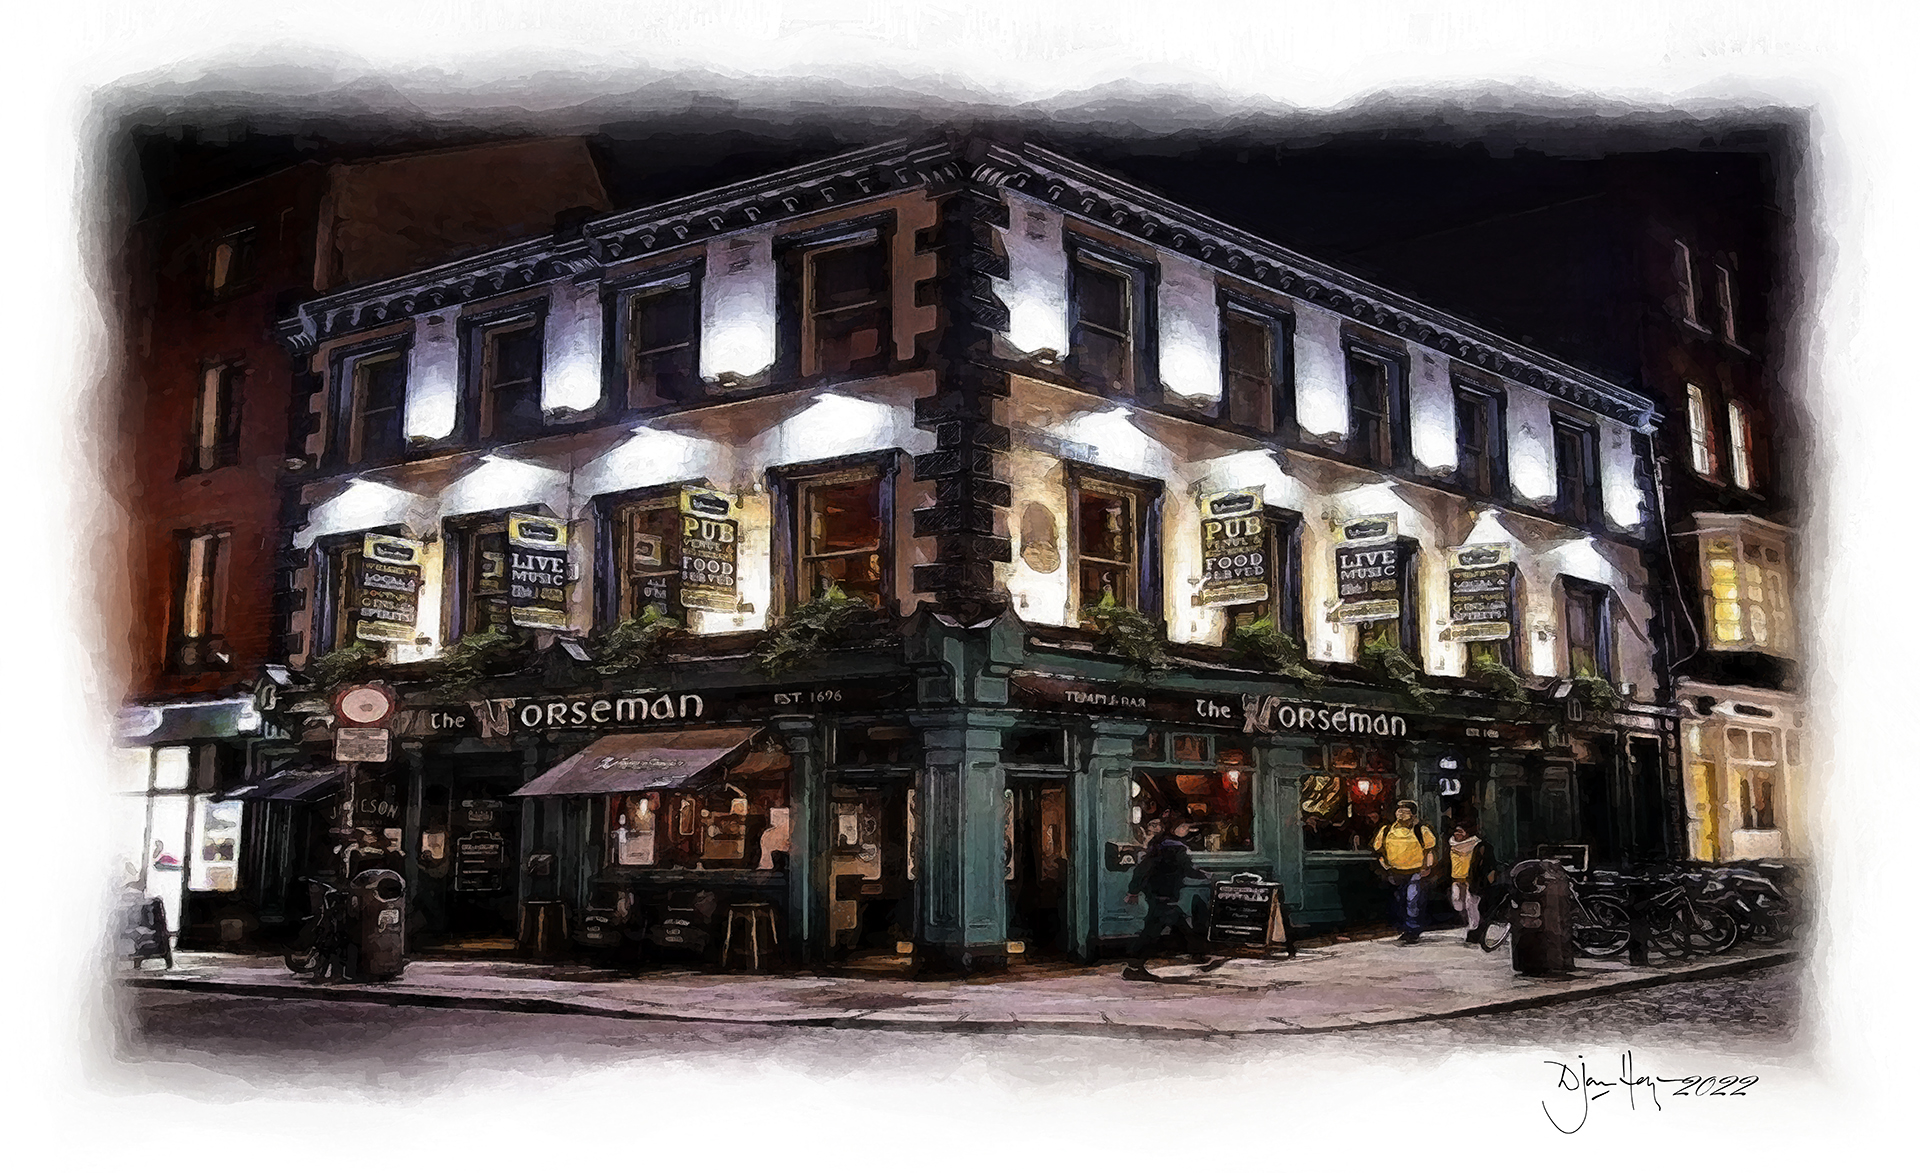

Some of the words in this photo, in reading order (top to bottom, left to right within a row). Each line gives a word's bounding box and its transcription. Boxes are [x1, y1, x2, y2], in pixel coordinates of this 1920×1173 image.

[683, 516, 734, 543] PUB
[1205, 516, 1262, 541] PUB
[511, 552, 564, 574] LIVE
[683, 556, 734, 575] FOOD
[1205, 552, 1263, 571] FOOD
[1340, 550, 1396, 569] LIVE
[511, 569, 564, 586] MUSIC
[1341, 565, 1396, 581] MUSIC
[810, 689, 843, 703] 1696
